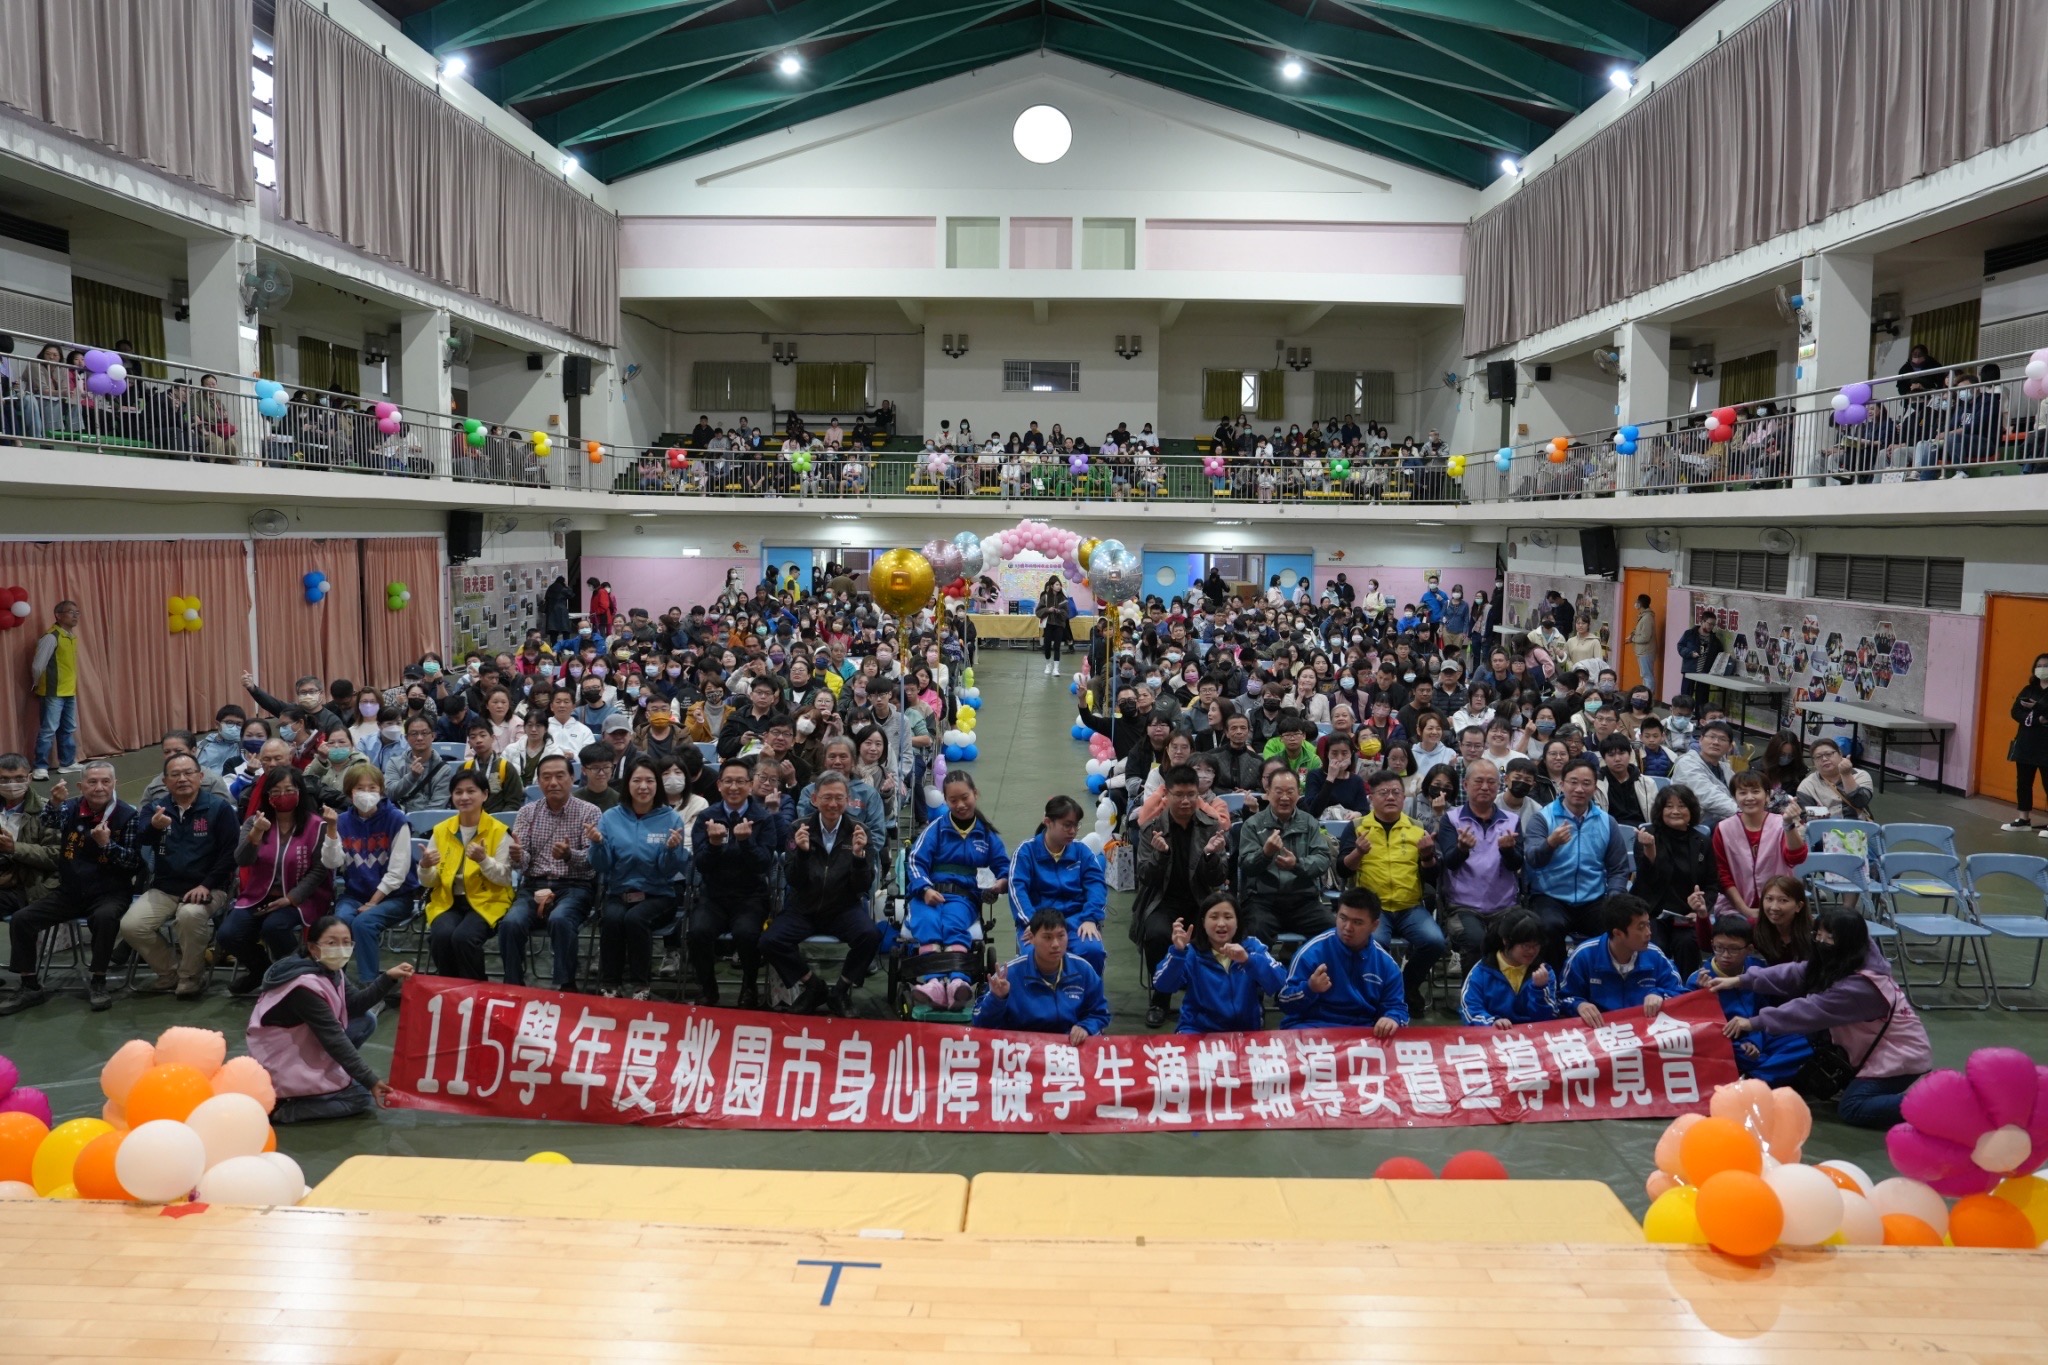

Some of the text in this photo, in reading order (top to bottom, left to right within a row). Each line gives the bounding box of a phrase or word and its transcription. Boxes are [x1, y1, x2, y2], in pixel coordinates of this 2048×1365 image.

[417, 993, 1700, 1125] 115學年度桃園市身心障礙學生適性輔導安置宣導博覽會
